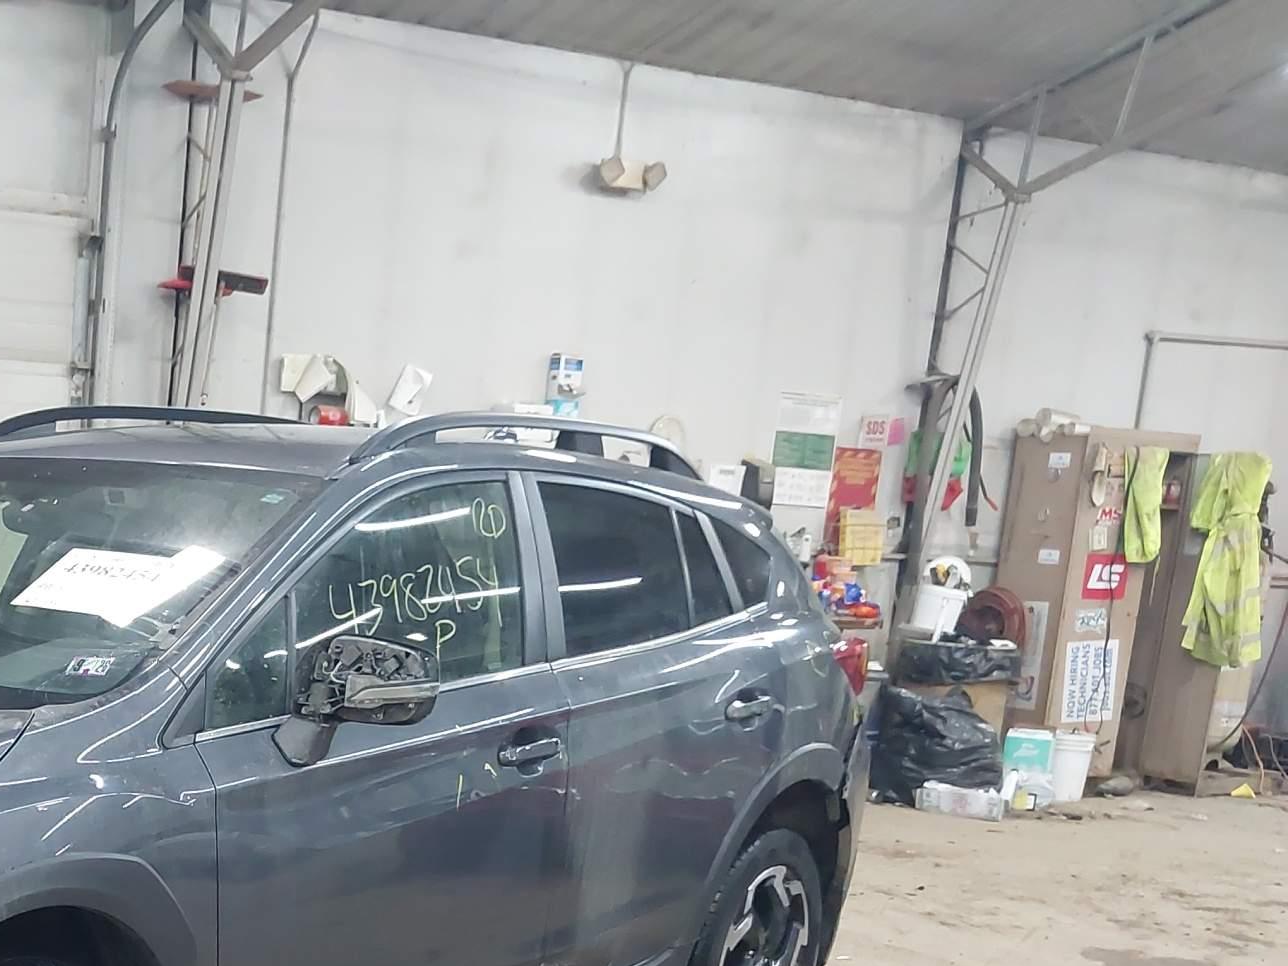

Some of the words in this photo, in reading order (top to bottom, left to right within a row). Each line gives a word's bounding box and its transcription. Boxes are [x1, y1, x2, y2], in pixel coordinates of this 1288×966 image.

[865, 420, 887, 436] SDS
[328, 556, 503, 636] 43982454
[1069, 646, 1080, 686] HIRING
[1077, 643, 1091, 719] TECHNICIANS
[1066, 689, 1076, 718] NOW
